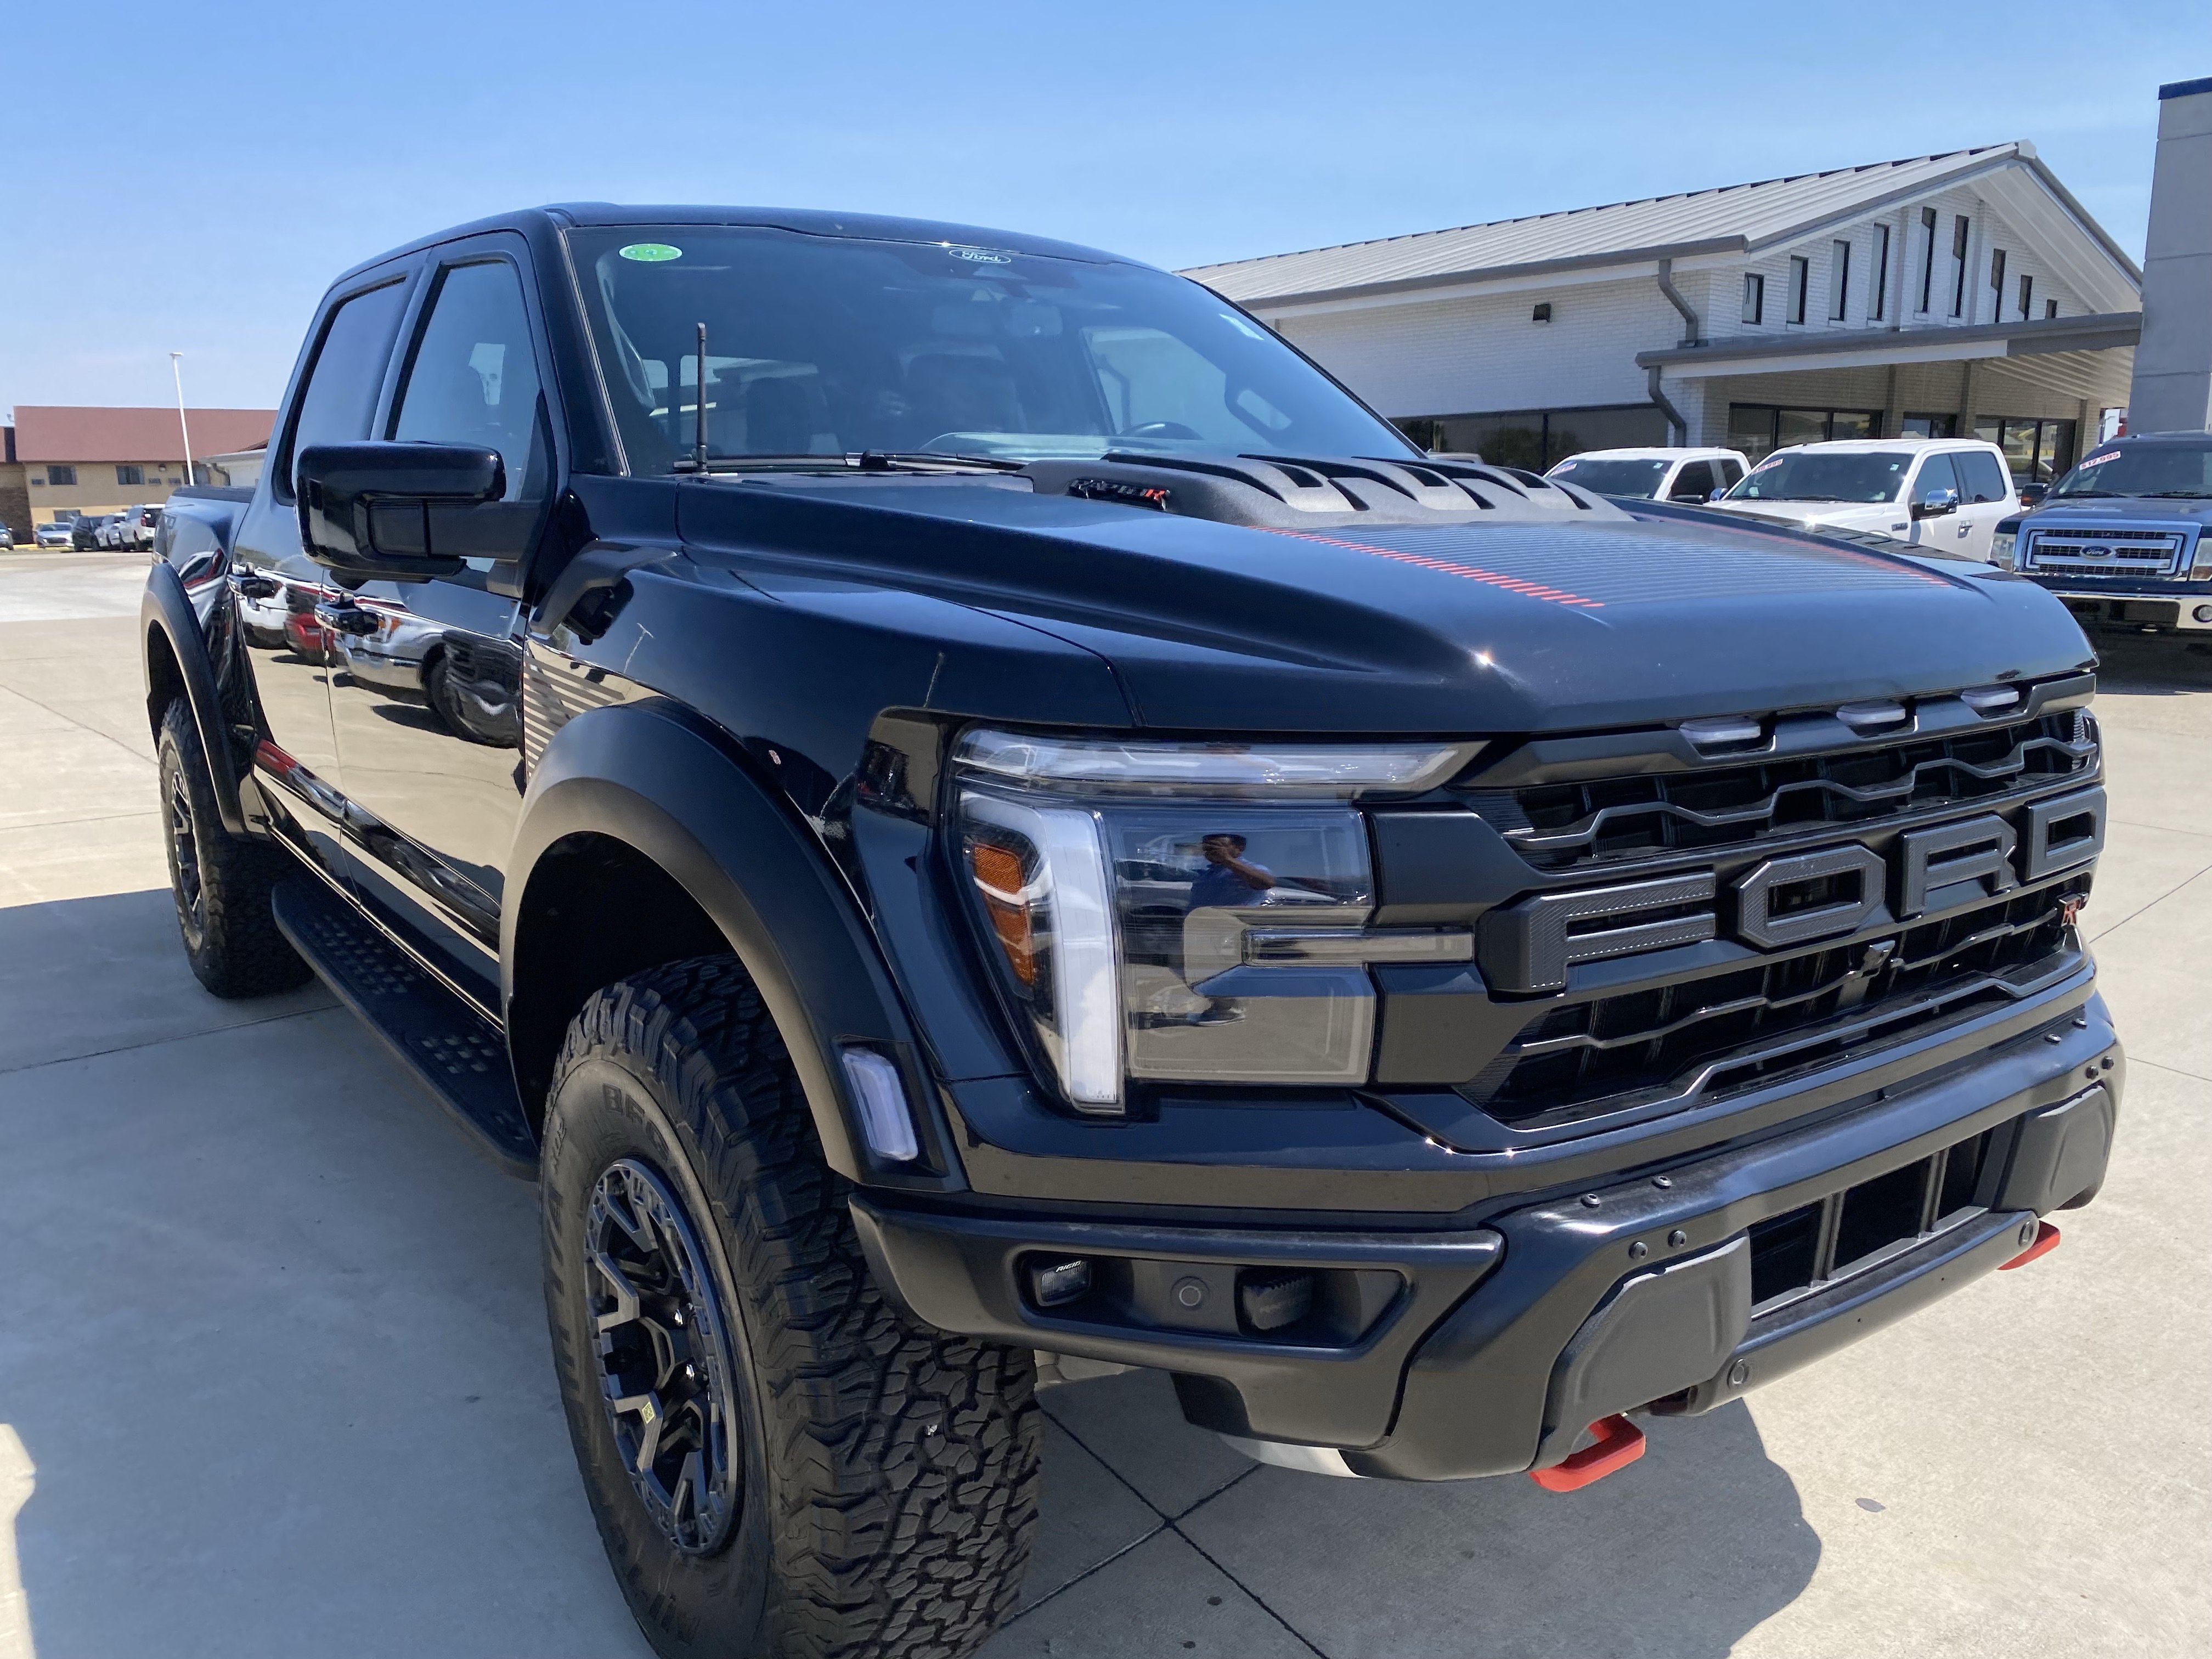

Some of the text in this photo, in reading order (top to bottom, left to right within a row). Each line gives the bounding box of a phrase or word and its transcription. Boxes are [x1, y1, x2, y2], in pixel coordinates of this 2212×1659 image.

[961, 251, 1001, 262] Ford
[1528, 786, 2107, 990] FORD
[1056, 1260, 1081, 1272] RIGID
